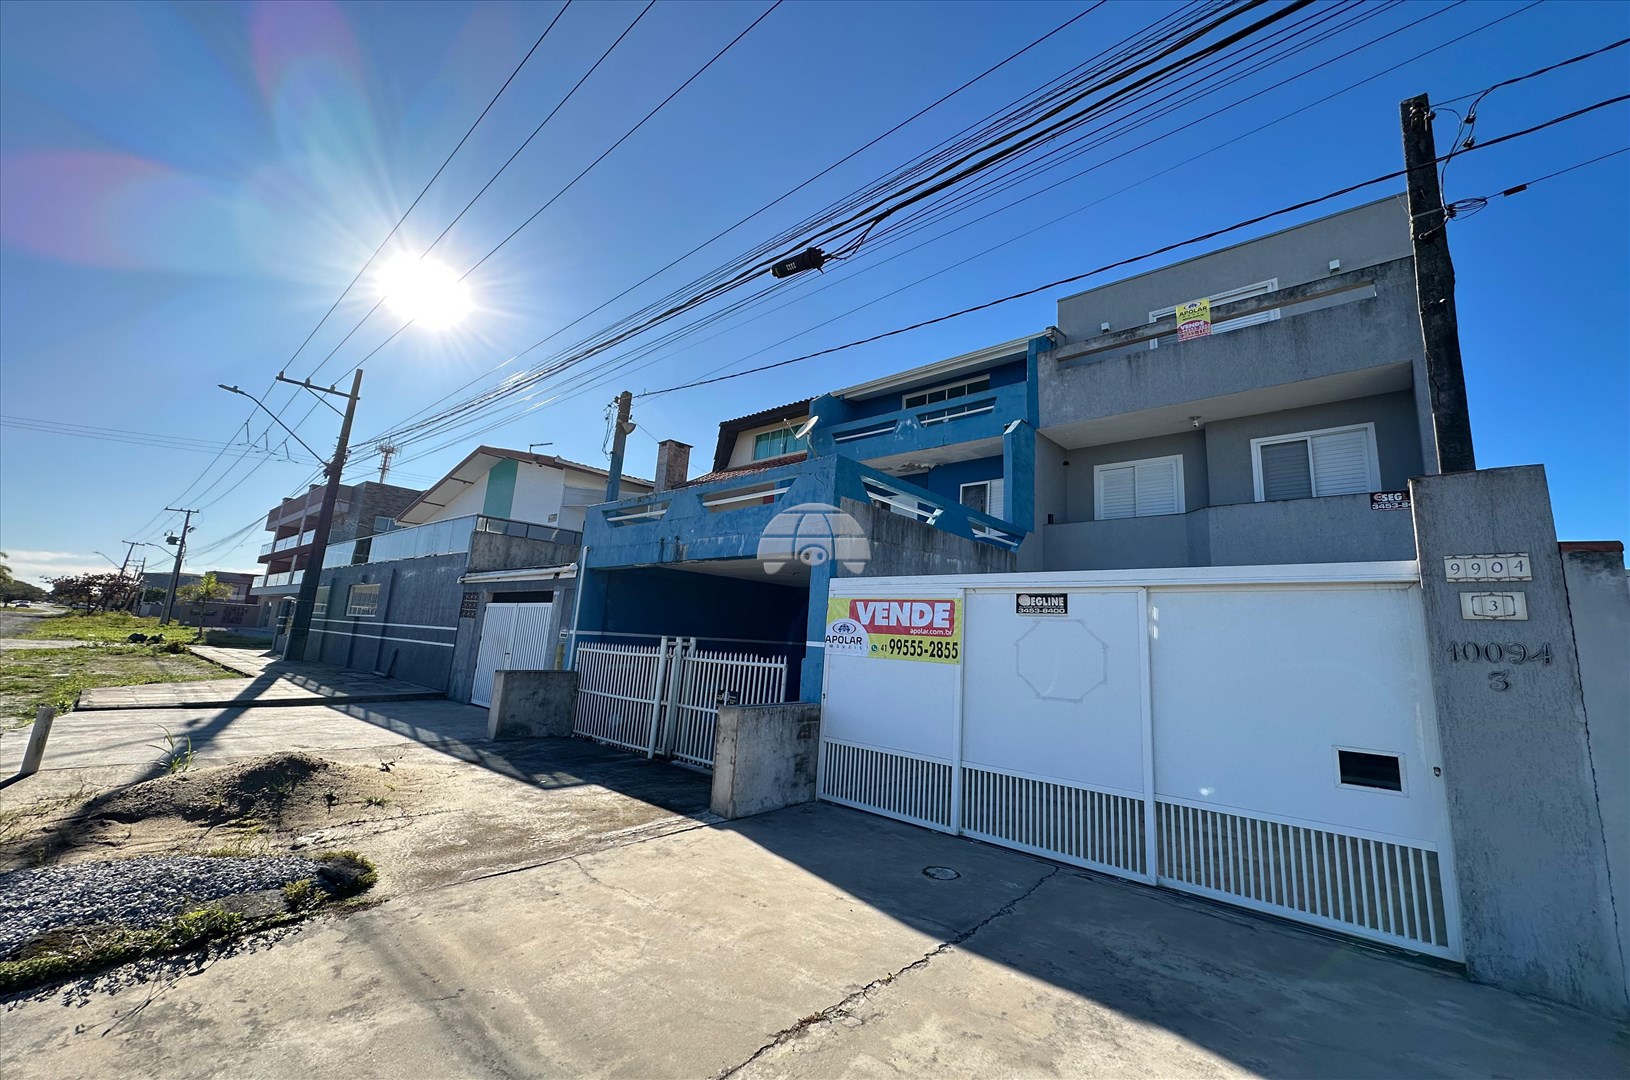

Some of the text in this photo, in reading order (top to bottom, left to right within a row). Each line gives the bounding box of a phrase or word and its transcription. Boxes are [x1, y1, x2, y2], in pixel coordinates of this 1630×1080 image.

[1179, 305, 1207, 317] APOLAR
[1372, 501, 1411, 510] 3453-8
[1450, 560, 1524, 575] 9904
[1488, 600, 1498, 612] 3
[855, 601, 951, 628] VENDE
[910, 628, 952, 637] apolar.com.br
[824, 635, 863, 646] APOLAR
[880, 638, 959, 659] 41 99555-2855
[1447, 641, 1552, 666] 10094
[1488, 669, 1511, 692] 3
